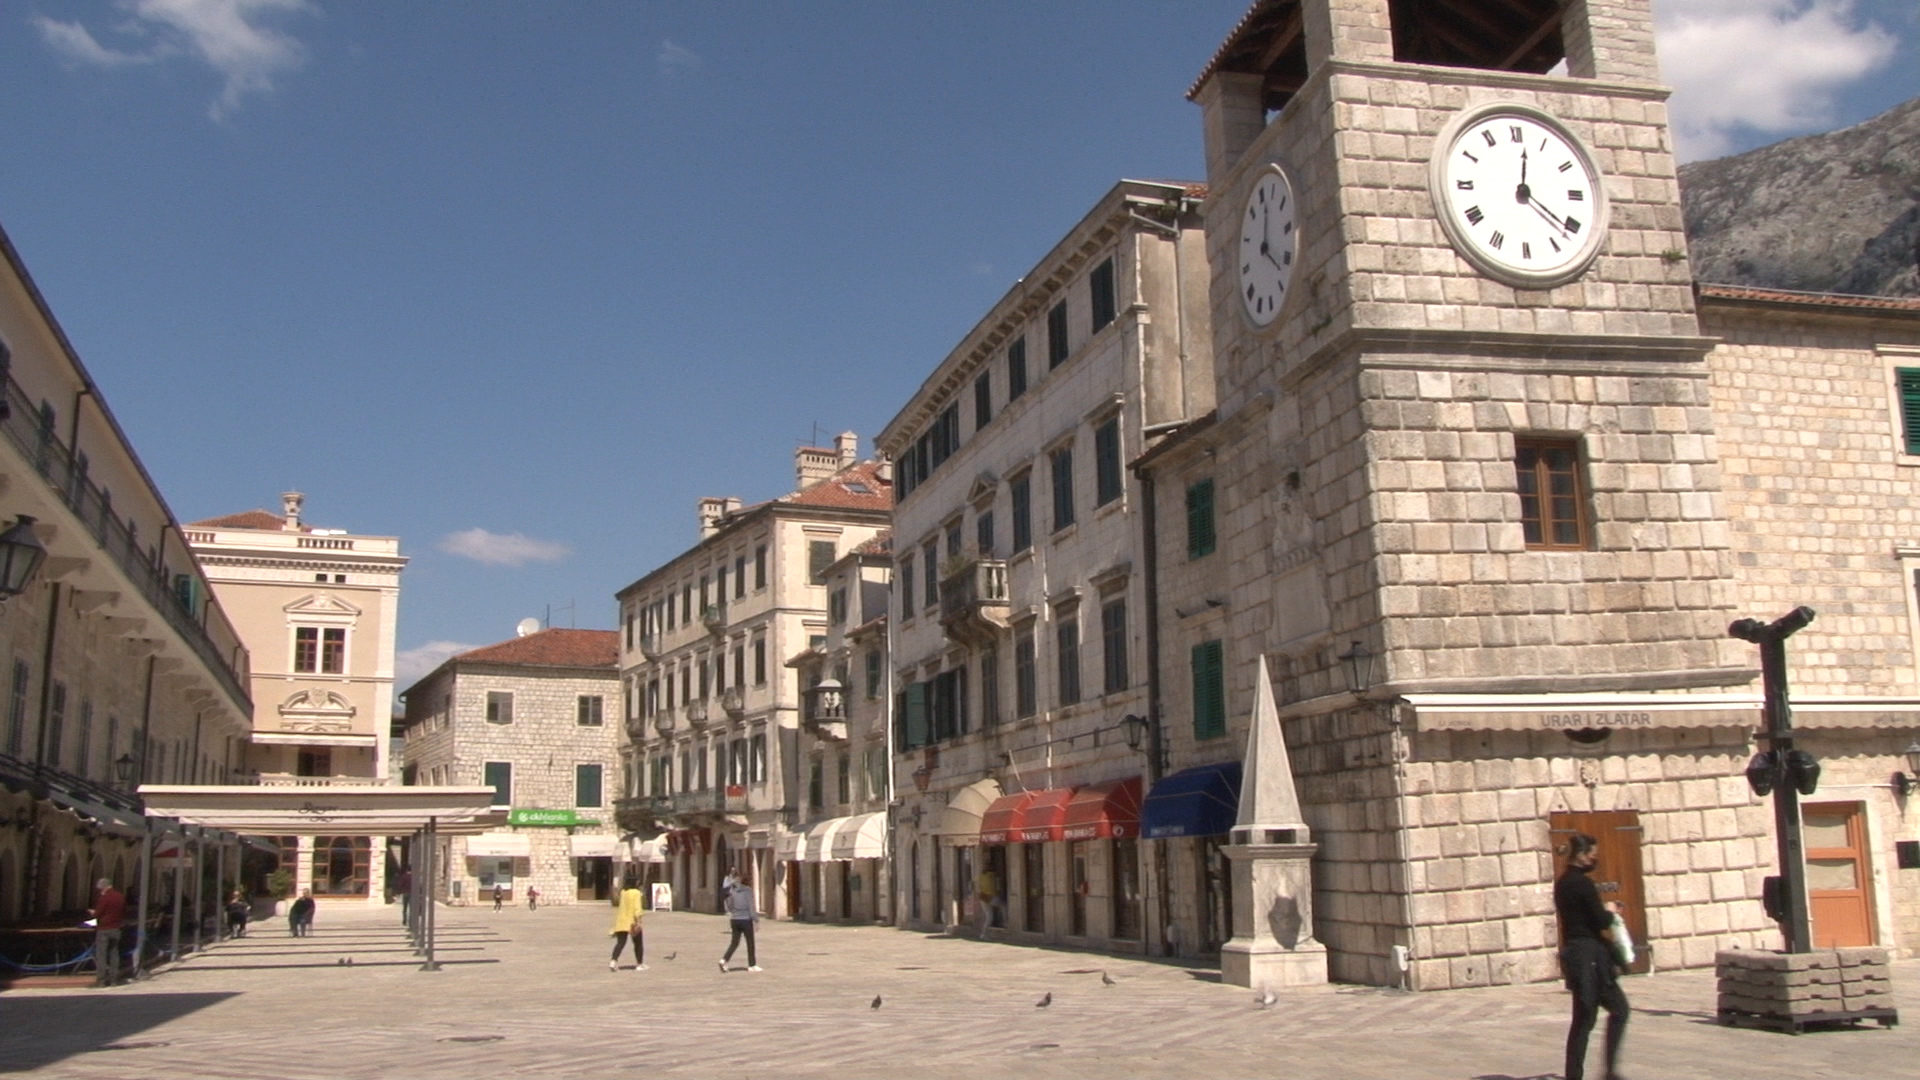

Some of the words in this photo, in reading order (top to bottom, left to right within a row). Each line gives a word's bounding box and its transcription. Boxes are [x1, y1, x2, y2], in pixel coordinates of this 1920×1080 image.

[1509, 125, 1523, 144] XII
[1557, 160, 1573, 173] II
[1567, 189, 1584, 202] III
[1488, 230, 1505, 251] VII
[1540, 714, 1582, 727] URAR
[1596, 712, 1652, 726] ZLATAR
